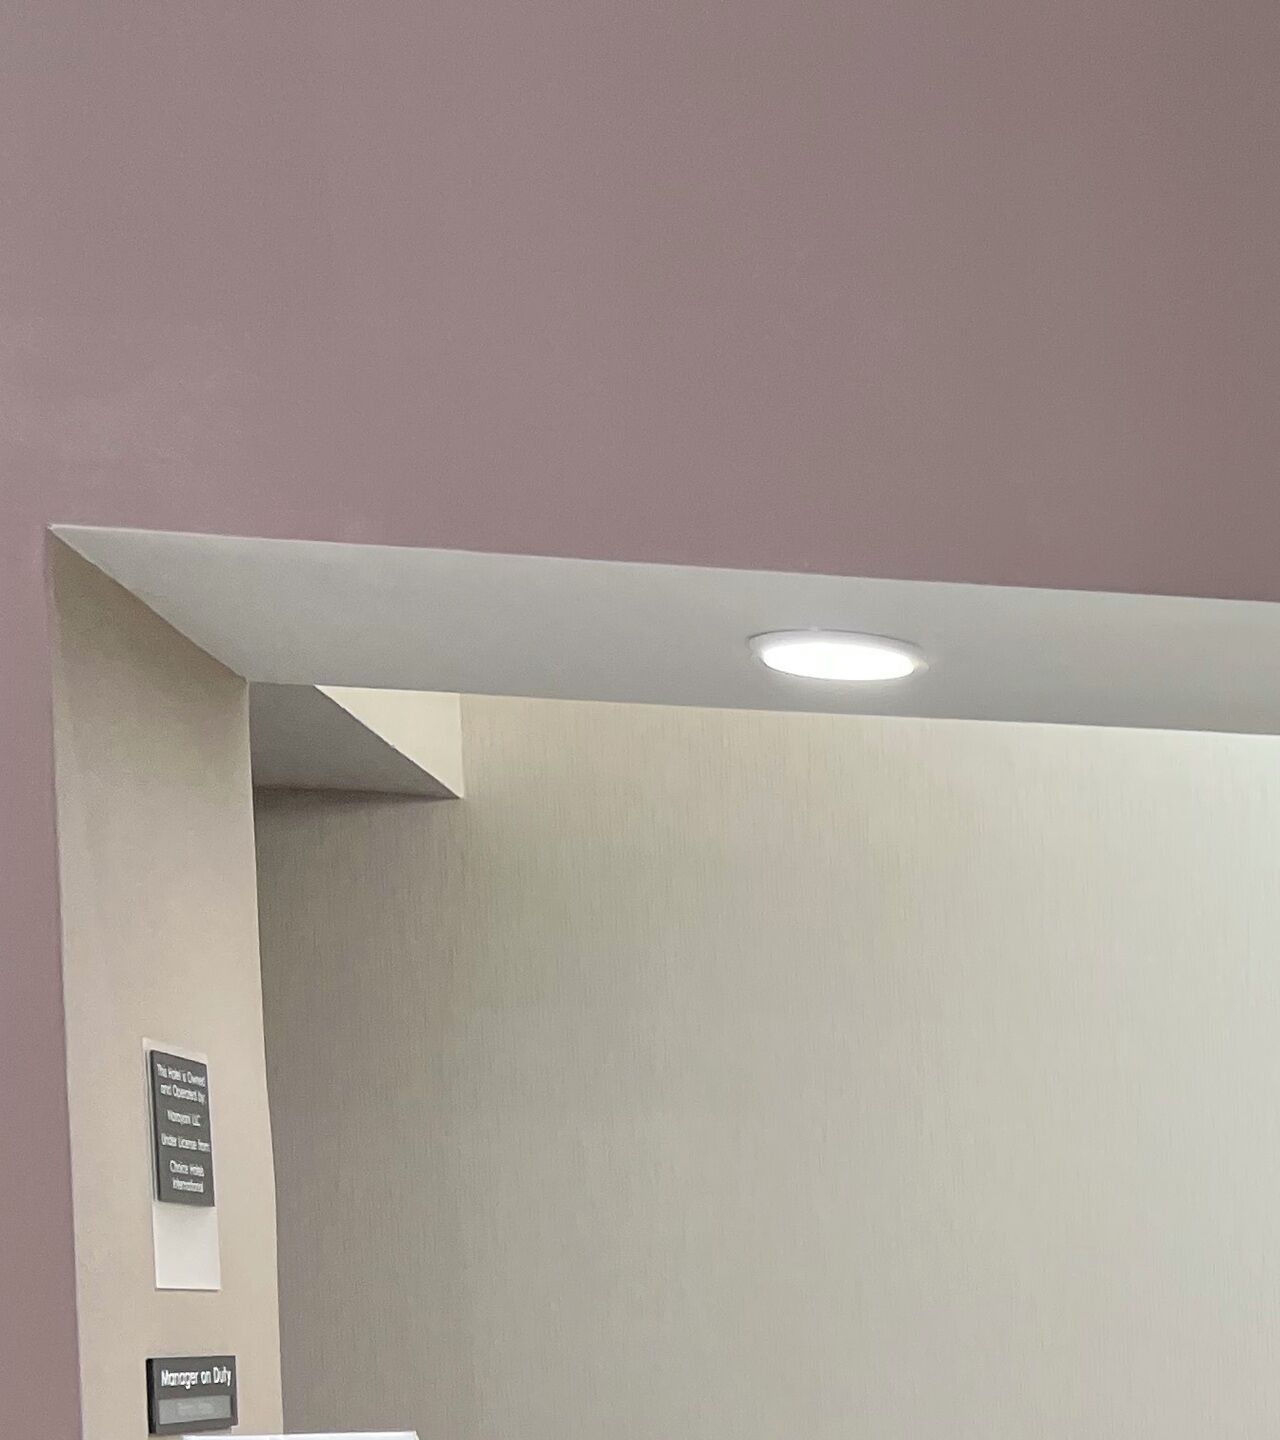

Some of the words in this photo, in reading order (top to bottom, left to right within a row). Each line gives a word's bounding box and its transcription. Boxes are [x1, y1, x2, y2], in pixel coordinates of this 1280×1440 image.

[161, 1369, 198, 1389] Manager
[201, 1371, 211, 1384] on
[213, 1366, 231, 1387] Duty
